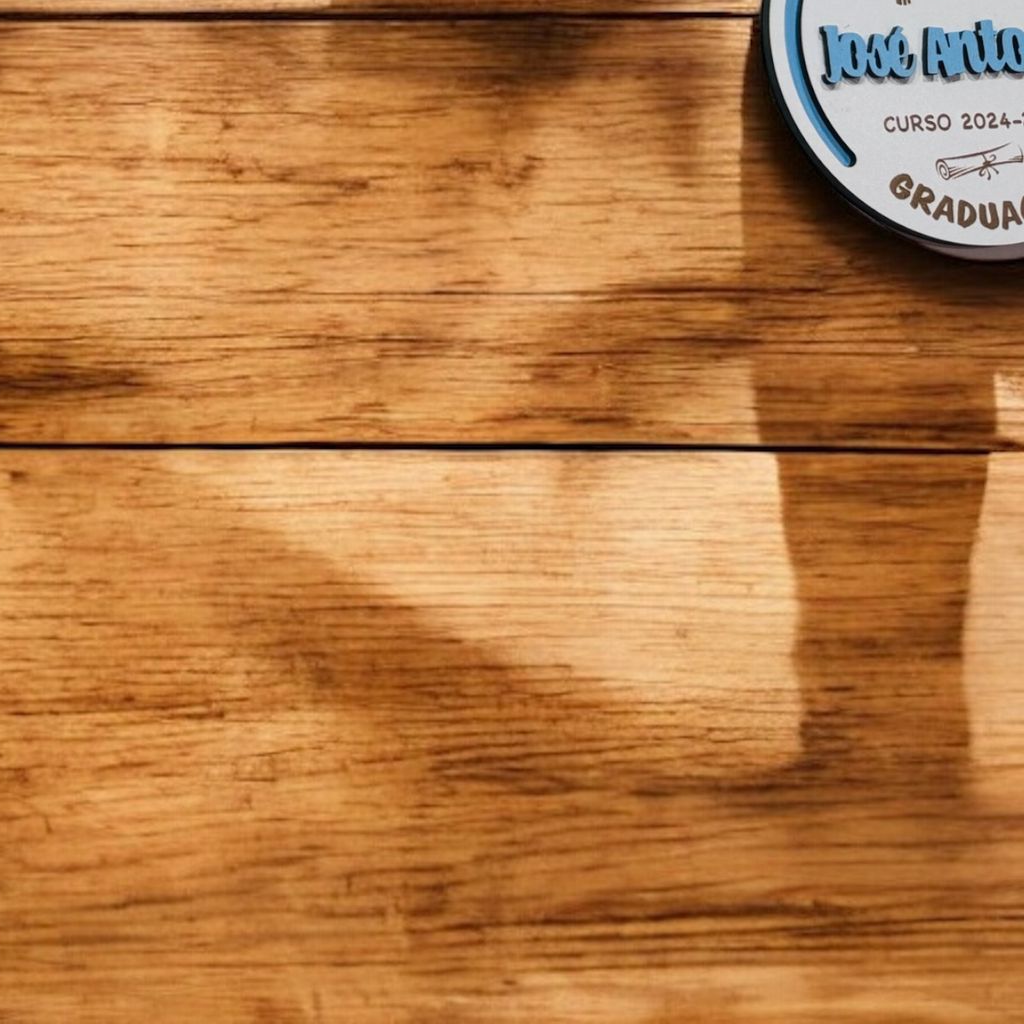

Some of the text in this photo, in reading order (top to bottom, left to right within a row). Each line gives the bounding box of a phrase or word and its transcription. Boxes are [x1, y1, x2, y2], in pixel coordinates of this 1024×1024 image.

[819, 22, 917, 88] José
[883, 111, 1024, 134] CURSO 2024-
[888, 172, 1024, 231] GRADUA
